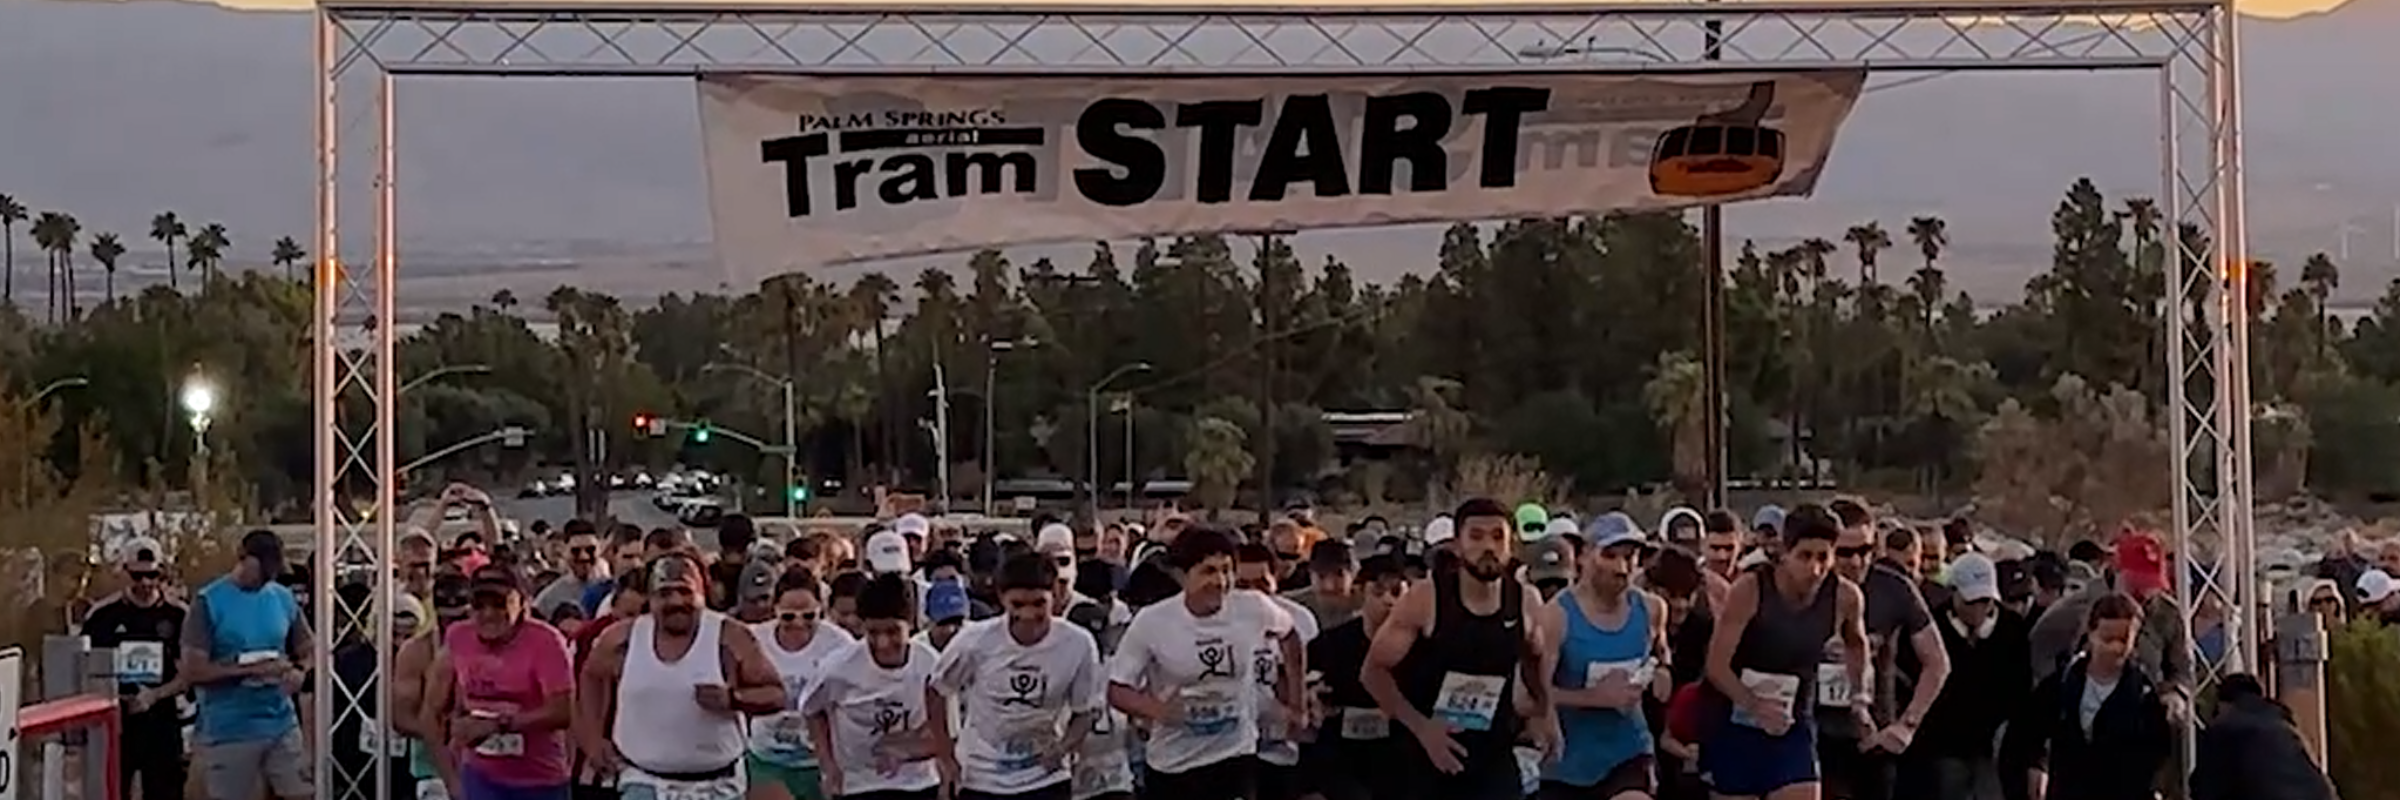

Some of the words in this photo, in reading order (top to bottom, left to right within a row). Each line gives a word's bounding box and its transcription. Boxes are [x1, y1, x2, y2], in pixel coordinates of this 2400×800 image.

[799, 112, 873, 132] PALM
[884, 108, 1006, 127] SPRINGS
[904, 129, 979, 145] aerial
[762, 131, 1037, 218] Tram
[1073, 87, 1551, 207] START
